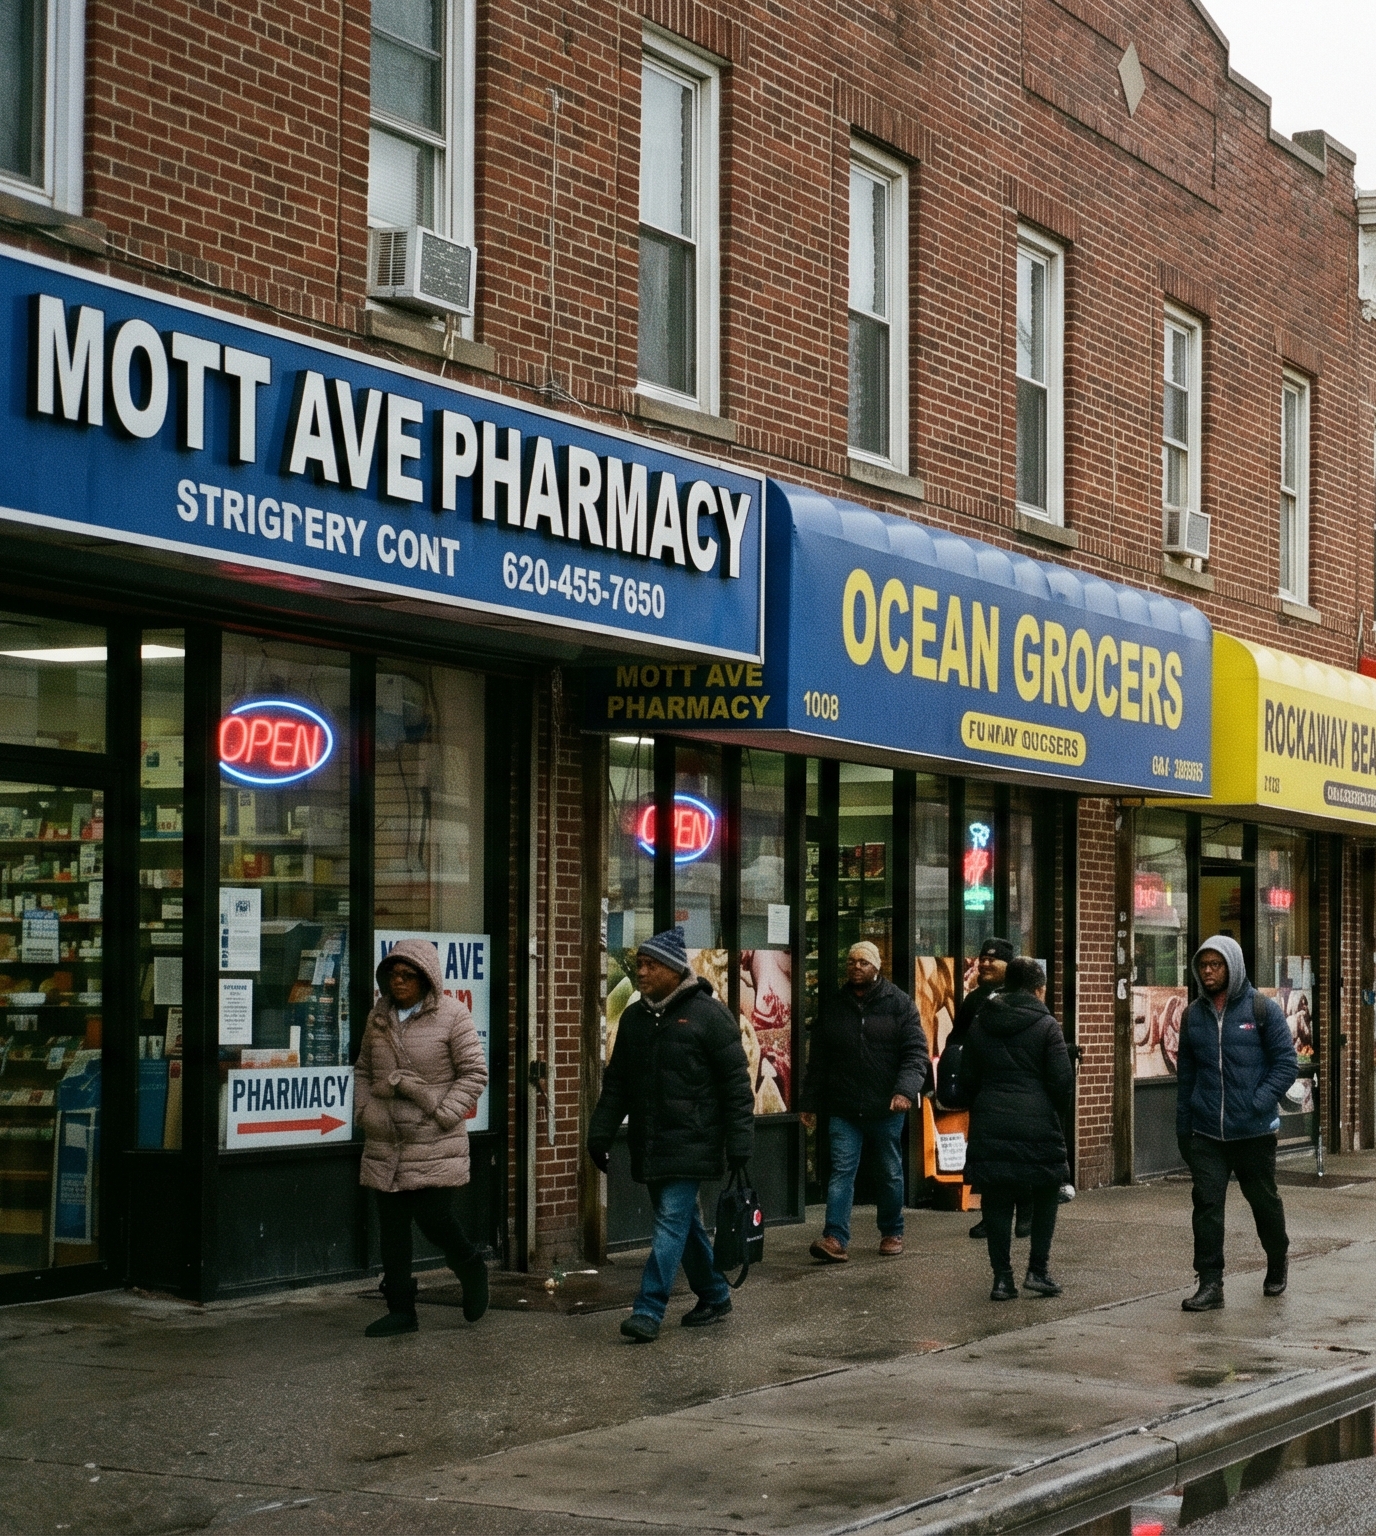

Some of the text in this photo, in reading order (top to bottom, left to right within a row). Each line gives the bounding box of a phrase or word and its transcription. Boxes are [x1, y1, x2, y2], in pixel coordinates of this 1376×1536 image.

[36, 293, 752, 579] MOTT AVE PHARMACY
[502, 551, 666, 620] 620-455-7650
[841, 568, 1184, 730] OCEAN GROCERS
[616, 663, 764, 688] MOTT AVE
[607, 695, 771, 719] PHARMACY
[803, 690, 840, 722] 1008
[218, 715, 320, 768] OPEN
[1264, 698, 1348, 770] ROCKAWAY
[641, 804, 710, 850] OEN
[445, 942, 485, 980] AVE
[232, 1074, 350, 1113] PHARMACY
